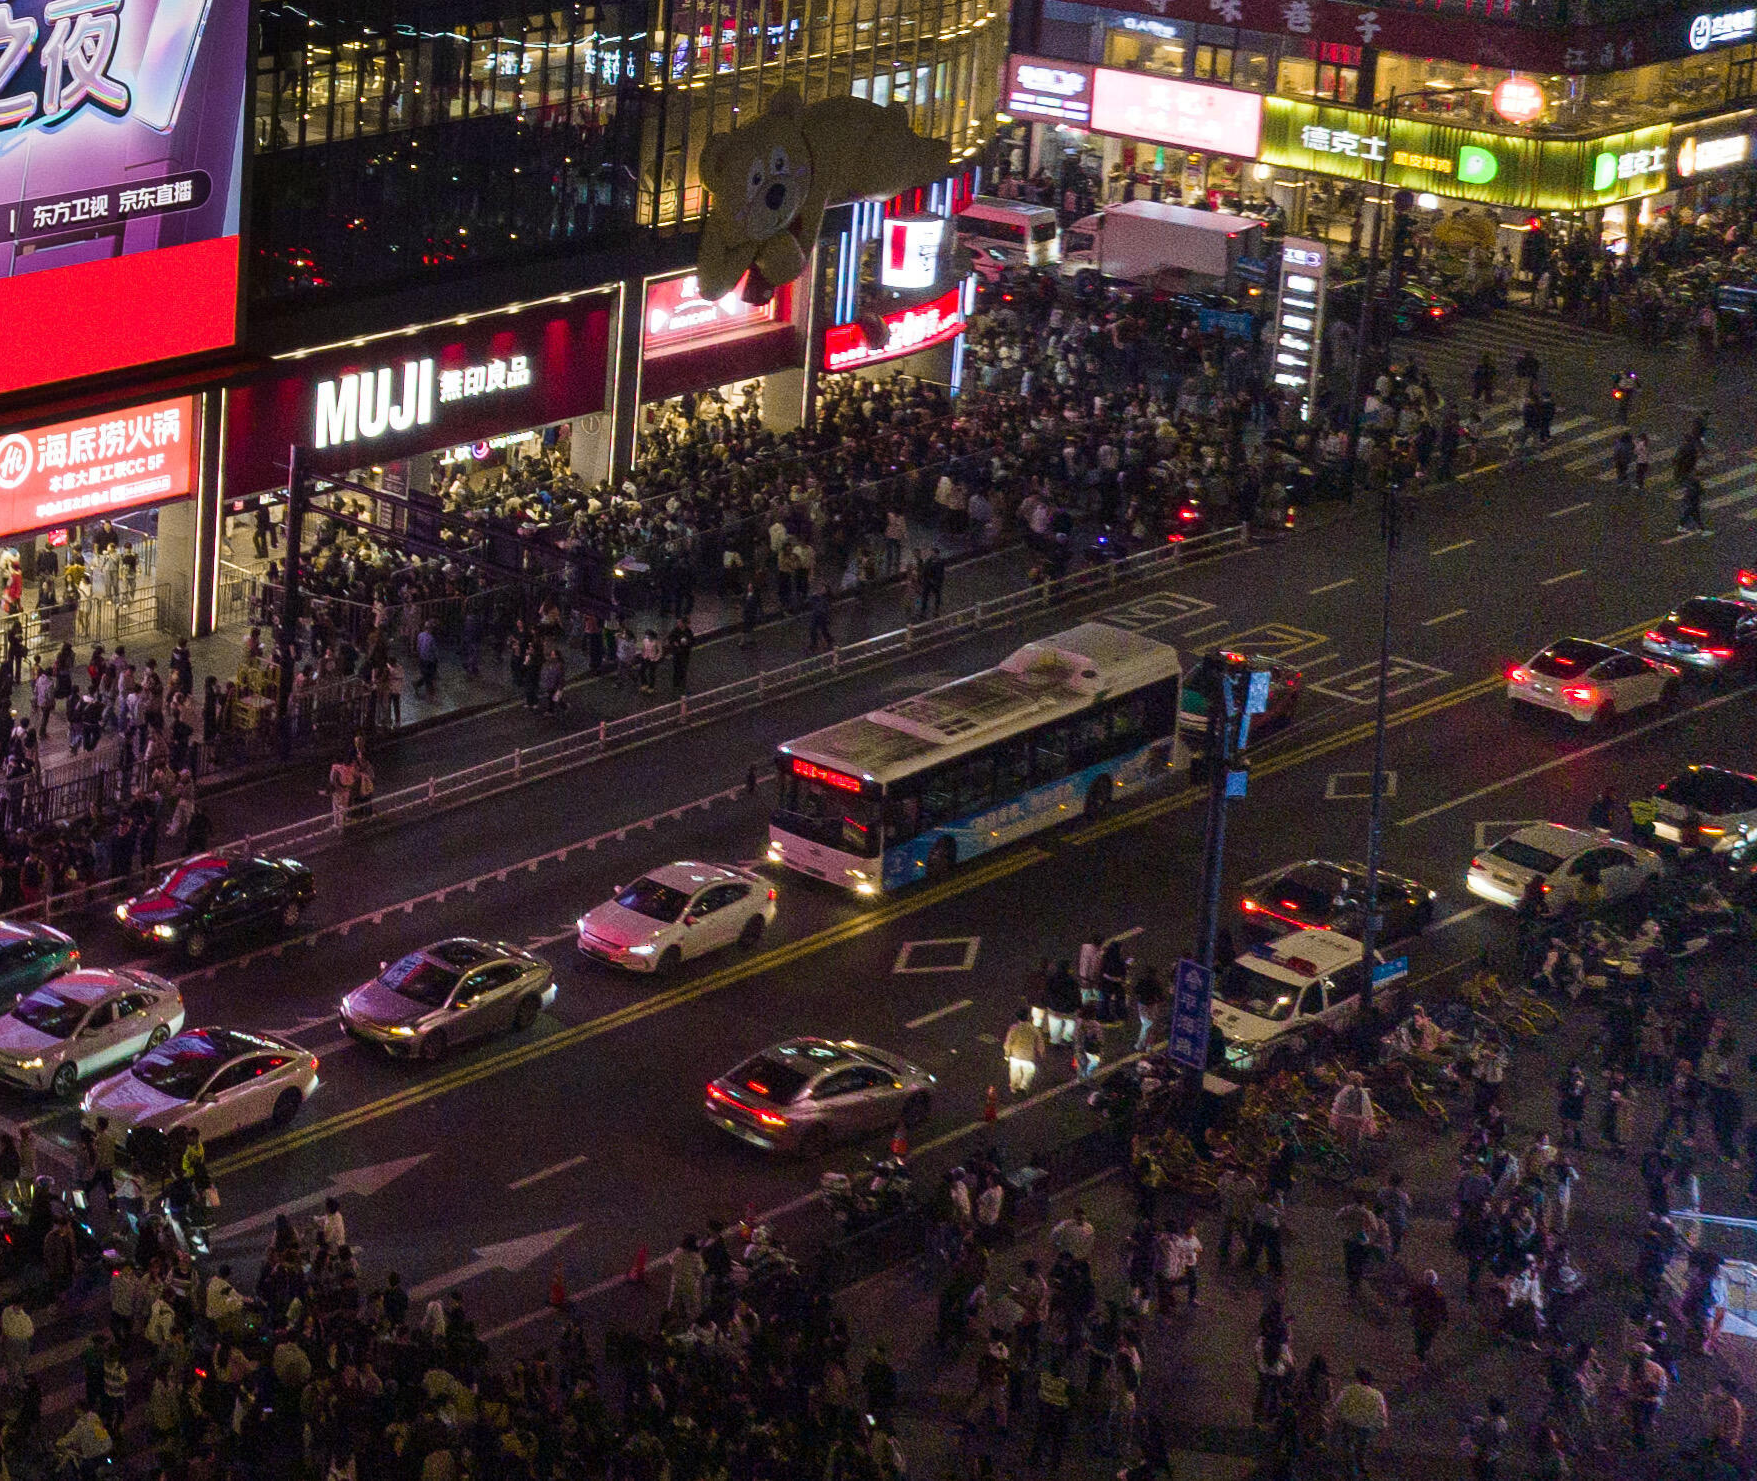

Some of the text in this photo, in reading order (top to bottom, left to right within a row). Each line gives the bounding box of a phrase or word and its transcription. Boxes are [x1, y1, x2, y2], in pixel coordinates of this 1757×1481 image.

[1301, 124, 1386, 162] 德克士
[1617, 145, 1667, 180] 德克士
[32, 195, 110, 230] 东方卫视
[118, 179, 194, 216] 京东直播
[314, 357, 435, 450] MUJI
[439, 355, 531, 403] 無印良品
[36, 407, 181, 473] 海底捞火锅
